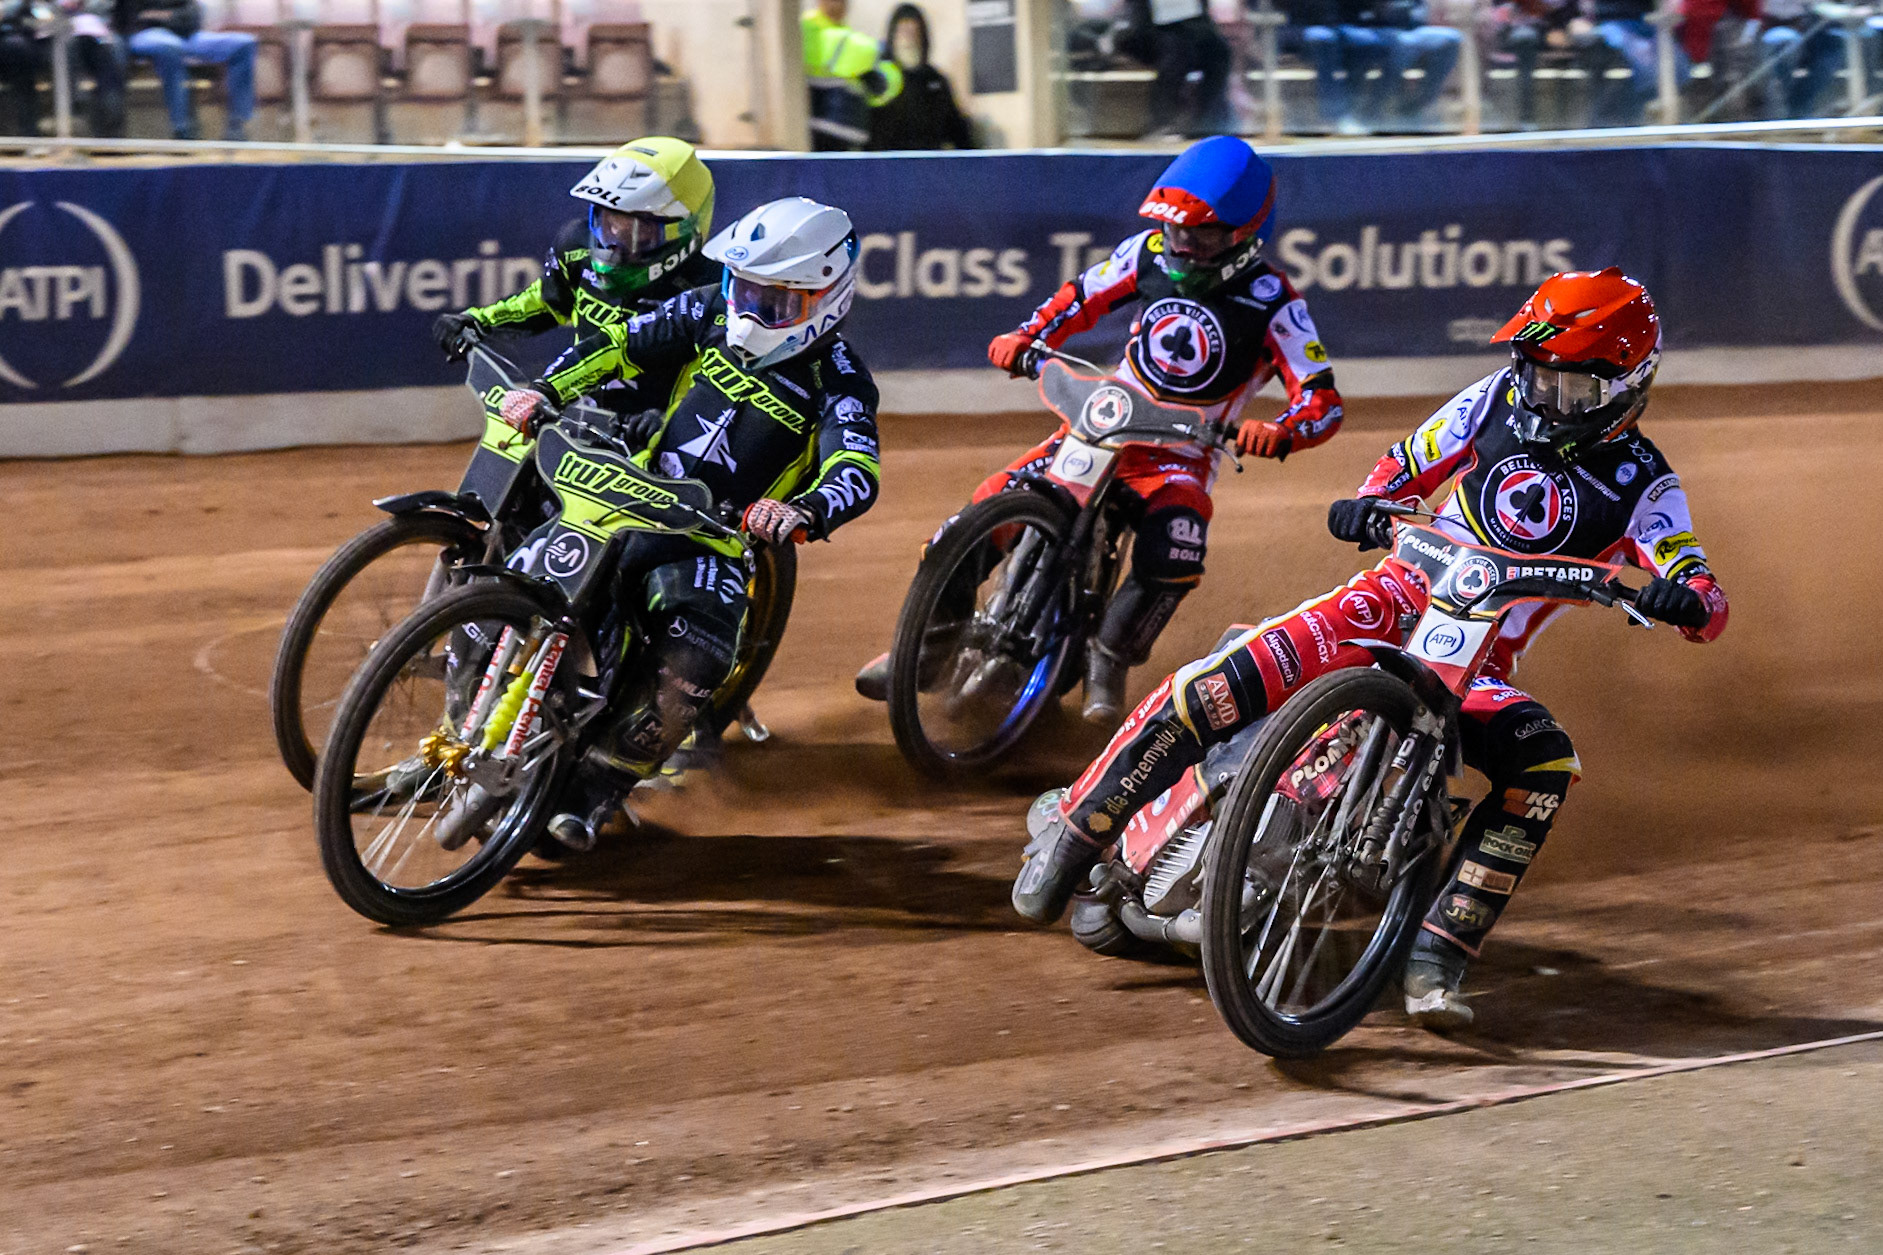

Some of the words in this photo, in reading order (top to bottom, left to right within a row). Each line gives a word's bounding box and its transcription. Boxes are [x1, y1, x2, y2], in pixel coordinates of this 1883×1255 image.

[575, 185, 622, 206] BOLL
[222, 241, 545, 319] Deliverin
[855, 231, 1032, 300] Class
[1276, 225, 1575, 291] Solutions
[0, 266, 107, 321] ATPI
[1205, 324, 1220, 354] ACES
[1573, 464, 1622, 502] PREMIERSHIP
[1560, 488, 1573, 522] ACES
[1351, 594, 1375, 623] ATPI
[1429, 629, 1458, 648] ATPI
[1266, 632, 1294, 684] Alpodach
[1208, 678, 1238, 725] AMD
[1525, 807, 1552, 821] N
[1483, 838, 1514, 854] ROCK
